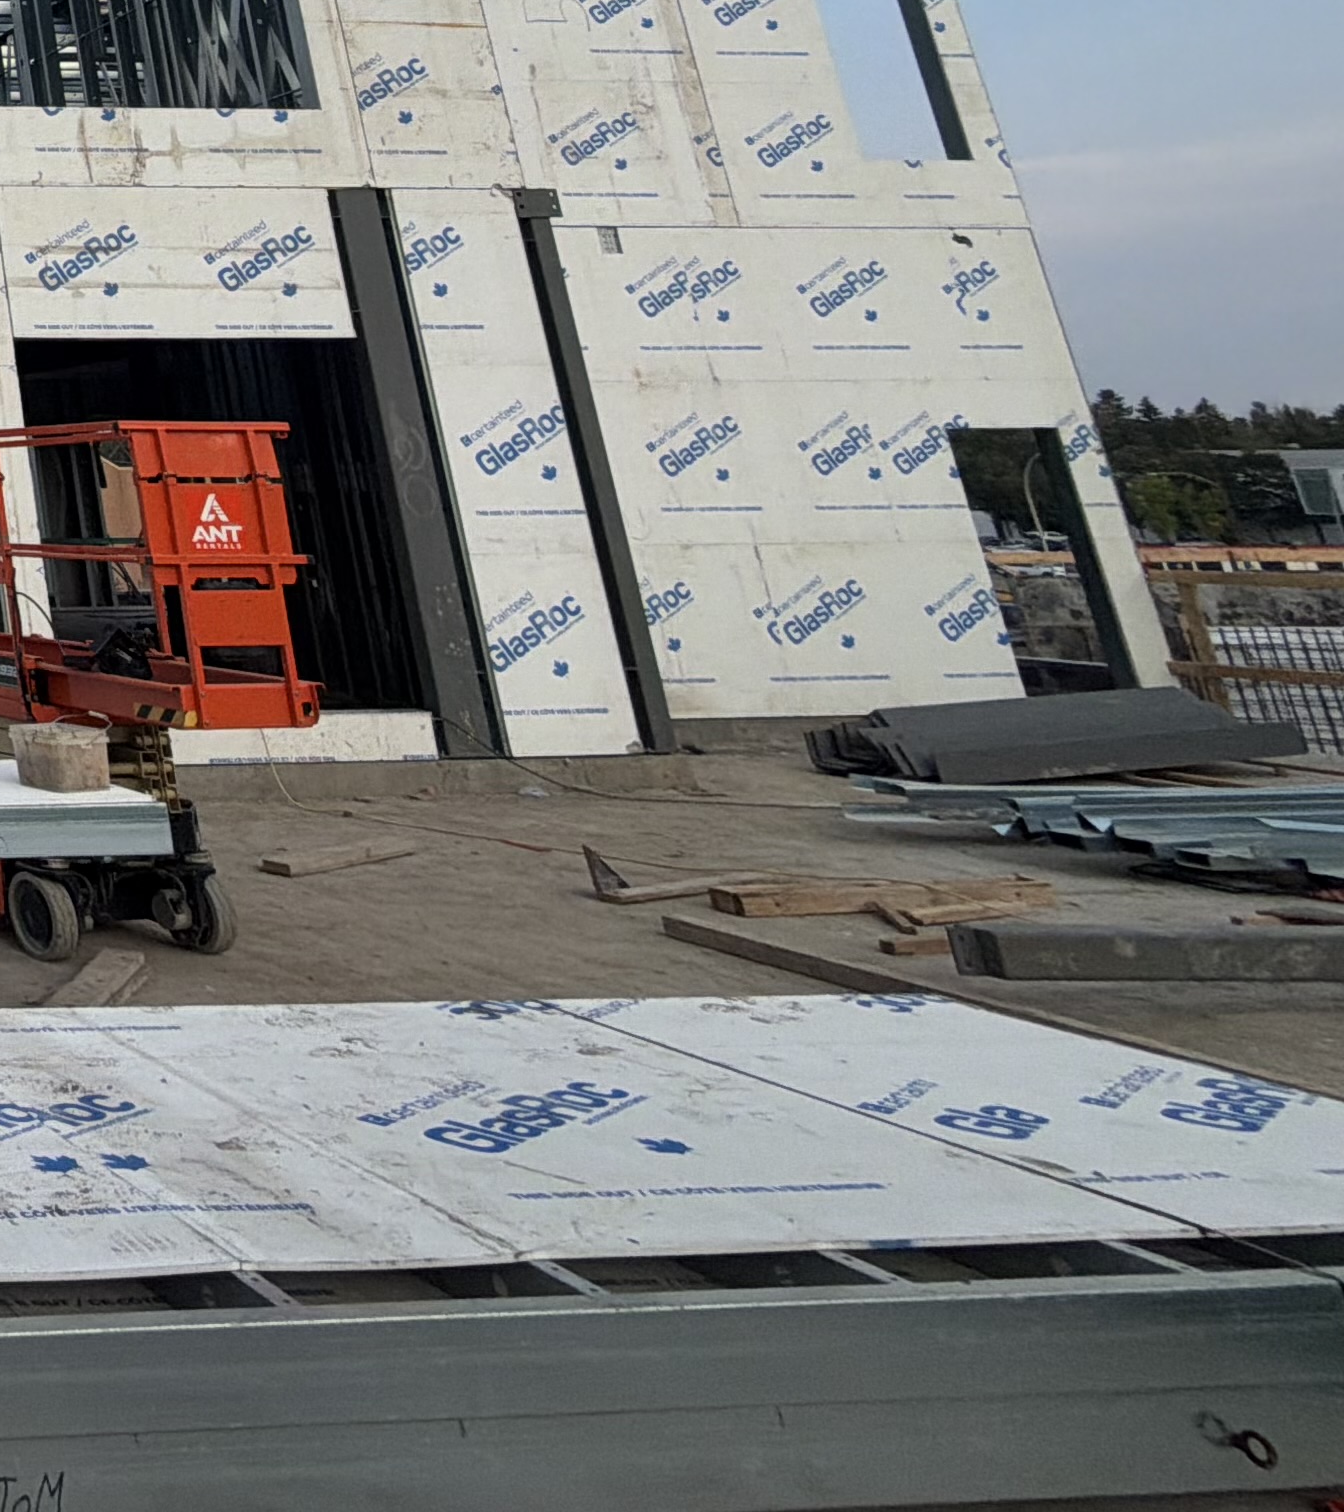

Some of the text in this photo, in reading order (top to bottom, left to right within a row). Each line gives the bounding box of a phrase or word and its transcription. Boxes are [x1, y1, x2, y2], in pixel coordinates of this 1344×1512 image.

[561, 112, 637, 167] GlasRoc
[758, 114, 832, 168] GlasRoc
[39, 225, 137, 292] GlasRoc
[217, 225, 314, 293] GlasRoc
[810, 261, 886, 319] GlasRoc
[659, 415, 739, 478] GlasRoc
[192, 524, 243, 544] ANT
[490, 592, 583, 673] GlasRoc
[784, 579, 863, 646] GlasRoc
[423, 1081, 631, 1154] GlasRoc
